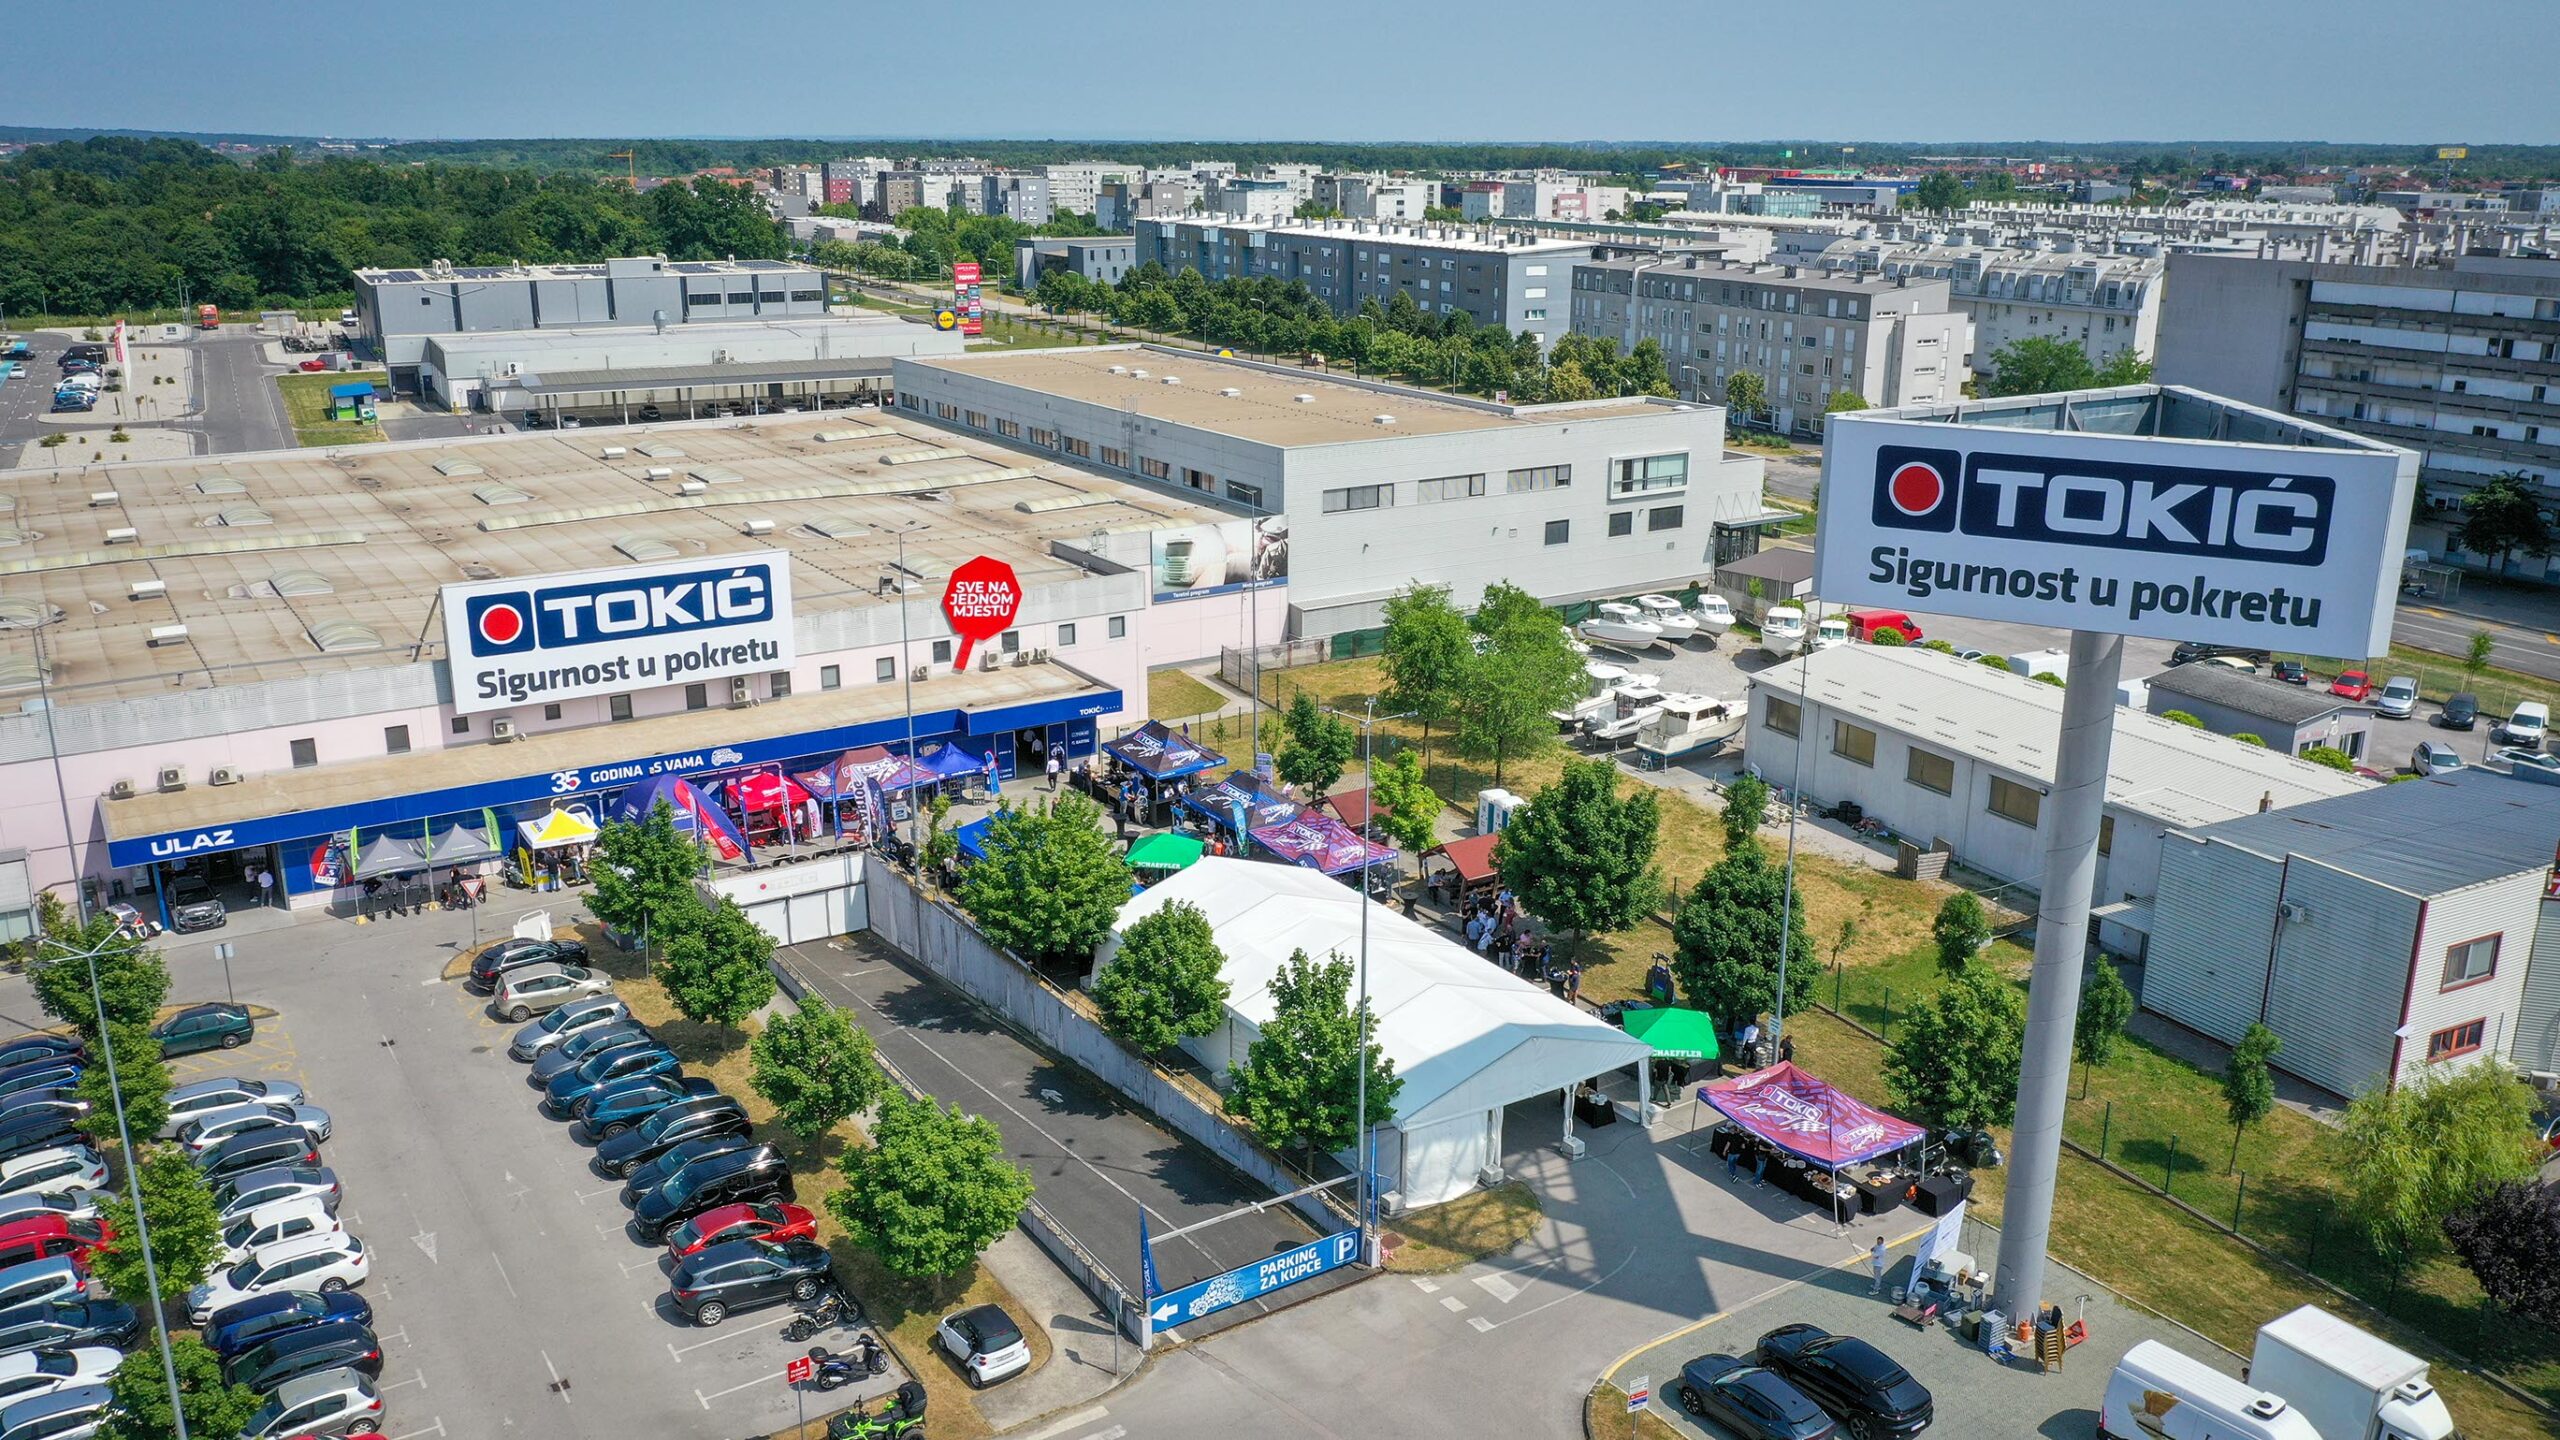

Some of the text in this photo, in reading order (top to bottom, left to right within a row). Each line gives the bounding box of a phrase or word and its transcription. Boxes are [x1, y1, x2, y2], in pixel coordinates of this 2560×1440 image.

[1976, 468, 2318, 553] TOKIĆ
[949, 593, 1013, 605] JEDNOM
[956, 581, 1009, 593] SVE NA
[1868, 546, 2321, 629] Sigurnost u pokretu
[543, 568, 765, 639] TOKIĆ
[953, 605, 1010, 617] MJESTU
[476, 638, 779, 702] Sigurnost u pokretu
[1080, 705, 1100, 716] TOKIĆ
[551, 770, 581, 793] 35
[590, 765, 643, 783] GODINA
[664, 754, 704, 771] VAMA
[150, 829, 235, 856] ULAZ
[1651, 1049, 1702, 1058] CHAEFFLER
[1260, 1247, 1318, 1277] PARKING
[1338, 1236, 1354, 1260] P
[1260, 1258, 1322, 1291] ZA KUPCE
